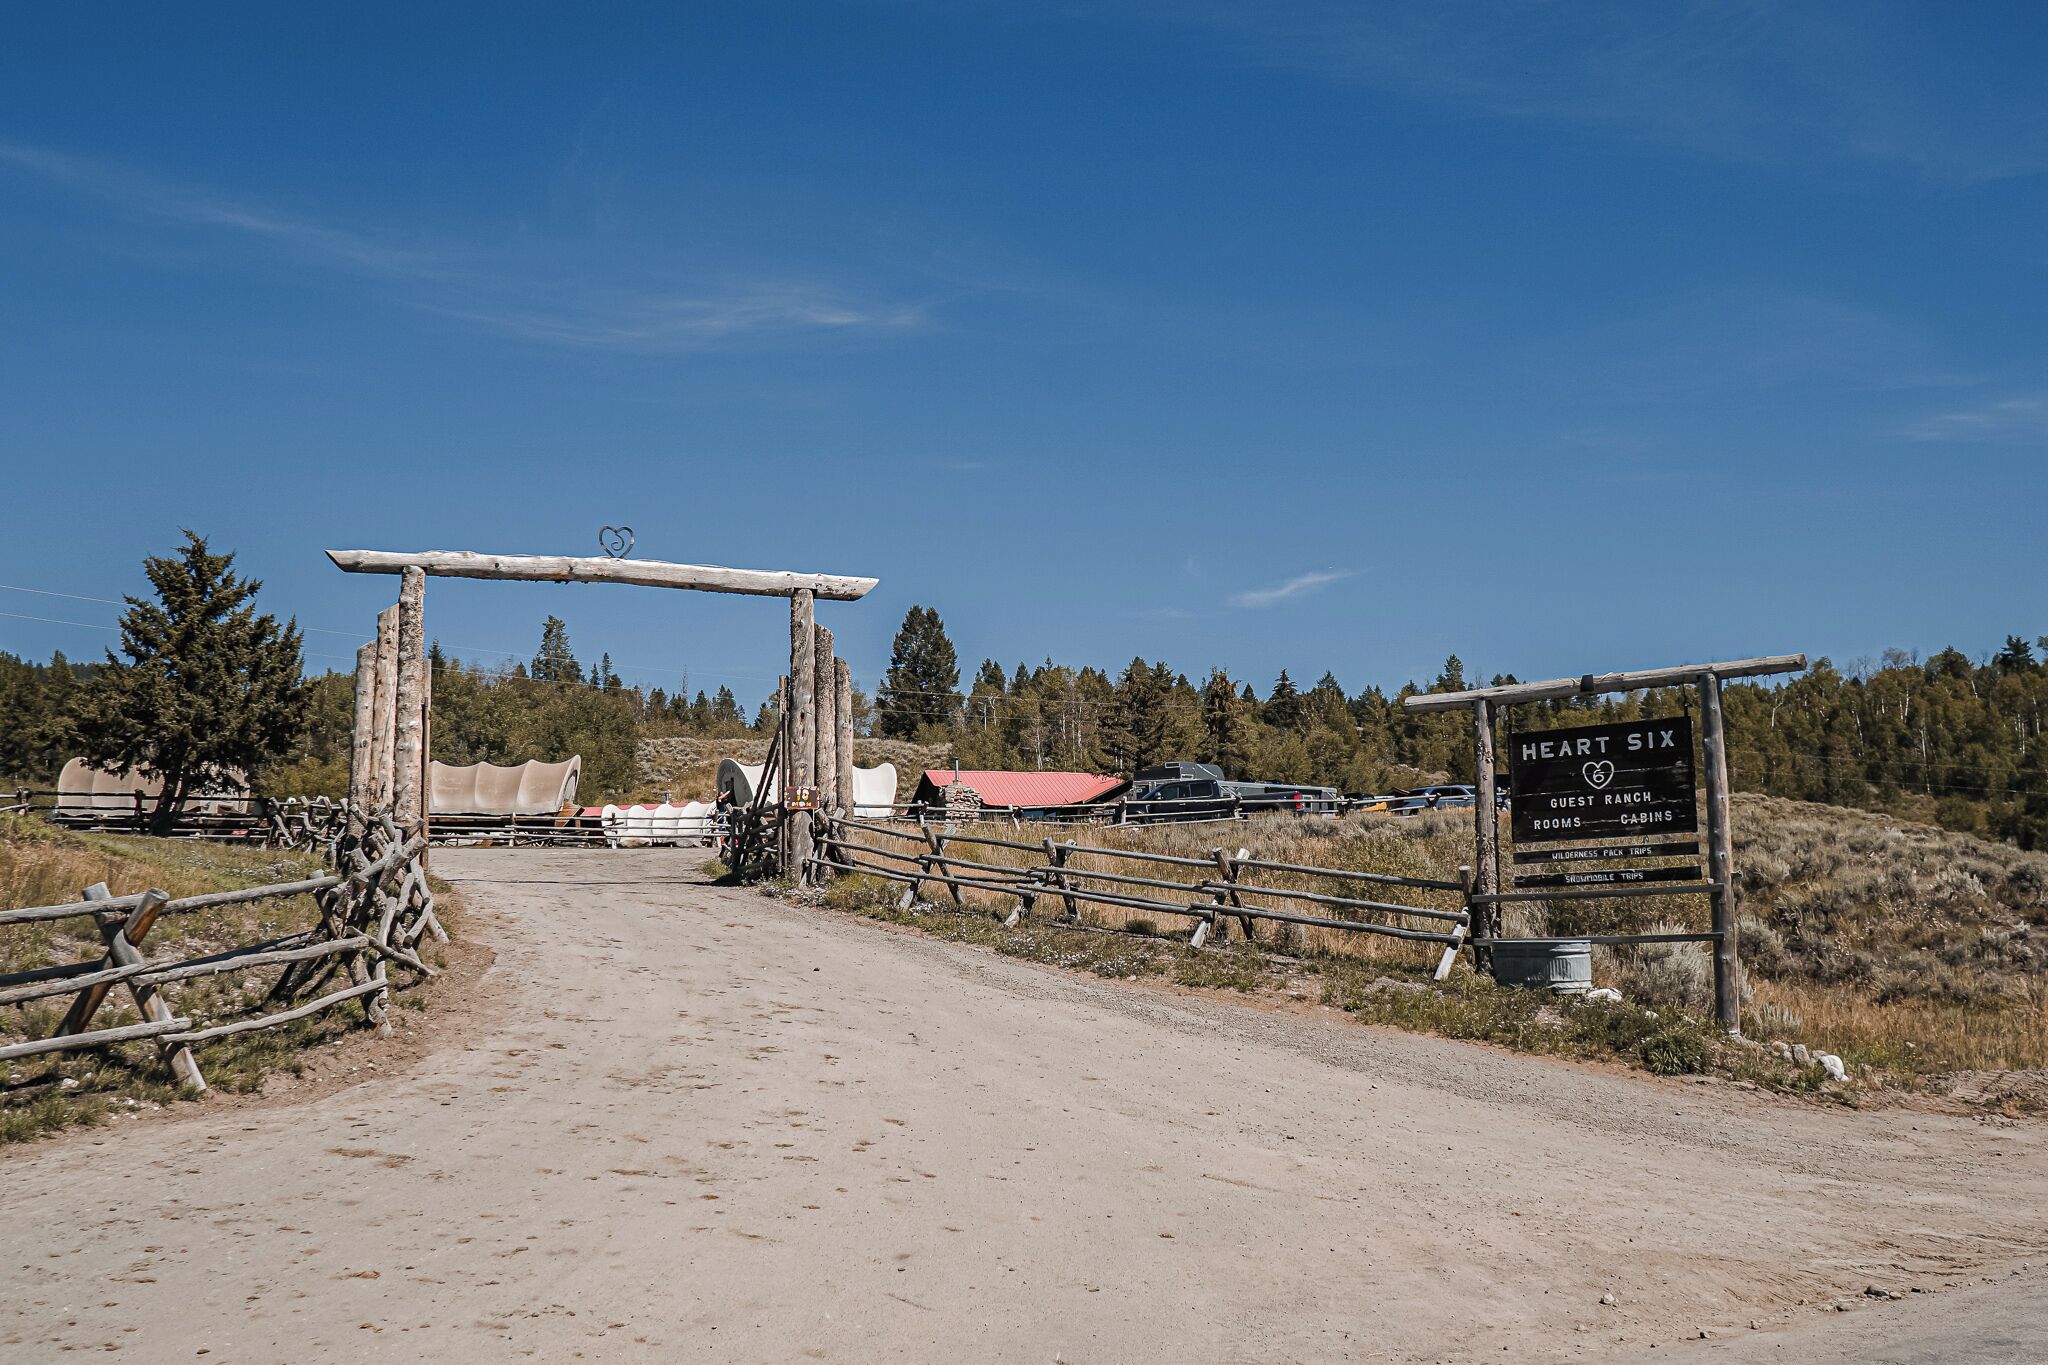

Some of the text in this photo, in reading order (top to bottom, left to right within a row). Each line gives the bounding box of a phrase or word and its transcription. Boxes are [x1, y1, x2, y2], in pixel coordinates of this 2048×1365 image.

[1522, 730, 1675, 761] HEART SIX
[1592, 768, 1605, 783] 6
[1550, 791, 1651, 809] GUEST RANCH
[1533, 810, 1673, 830] ROOMS CABINS
[1551, 847, 1652, 860] WILDERNESS PACK TRIPS
[1565, 872, 1644, 883] SNOWMOBILE TRIPS
